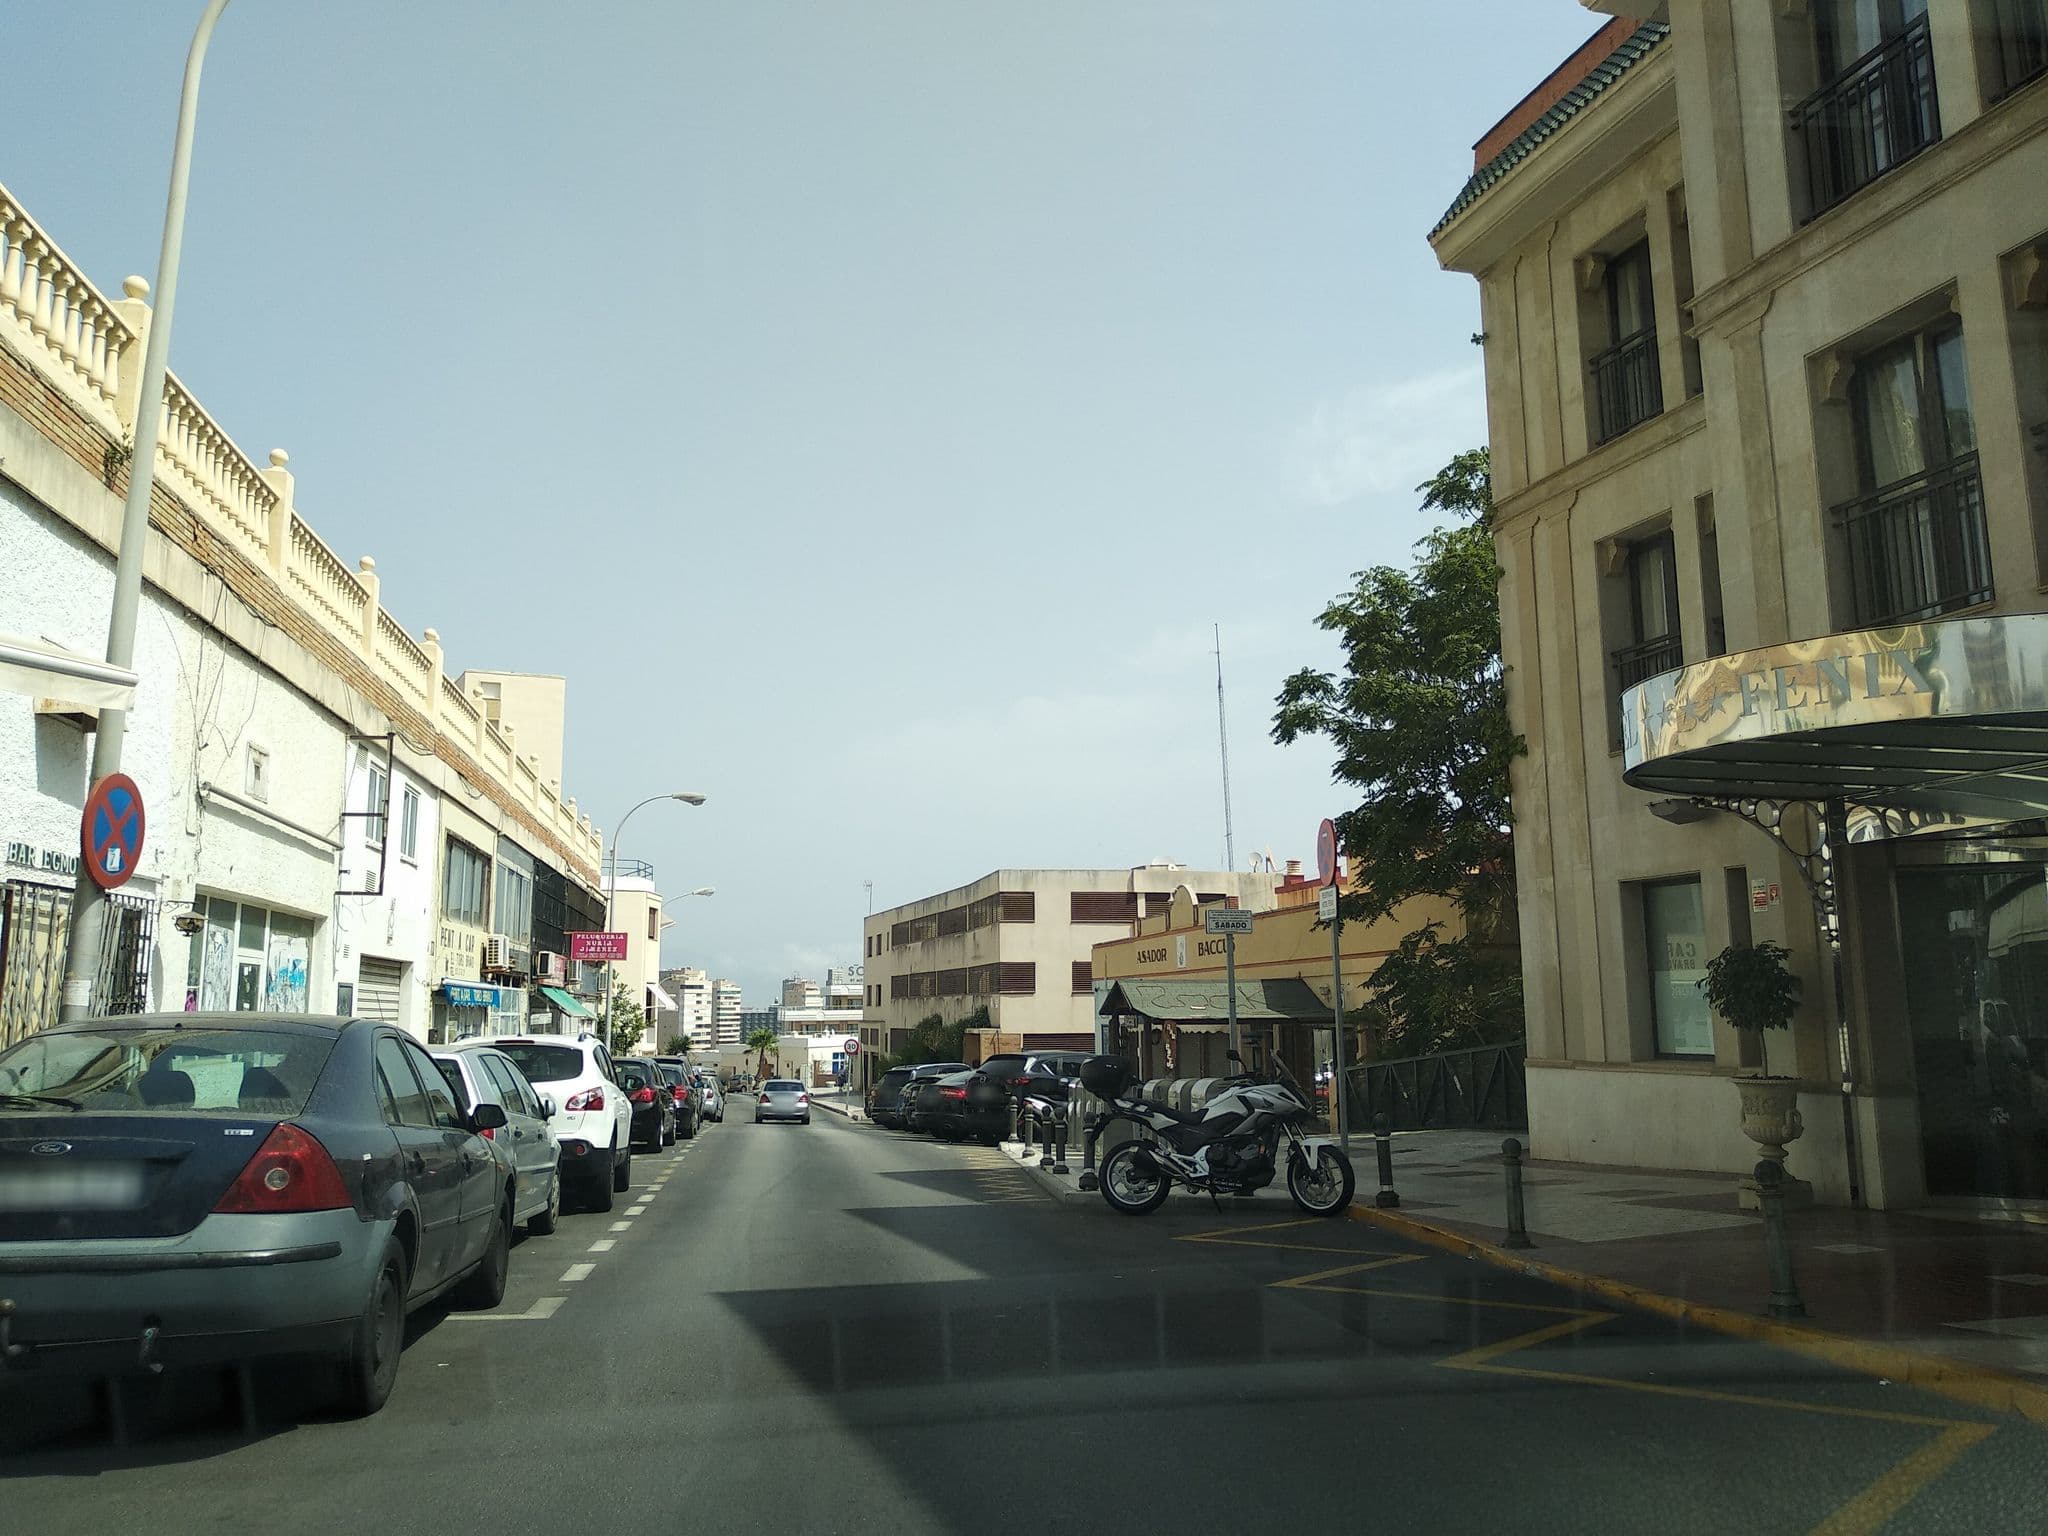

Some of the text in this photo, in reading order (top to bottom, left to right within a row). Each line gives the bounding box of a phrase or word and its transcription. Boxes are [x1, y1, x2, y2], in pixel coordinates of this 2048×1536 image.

[1739, 648, 1935, 718] FENIX
[8, 842, 40, 868] BAR
[1137, 948, 1167, 963] ASADOR
